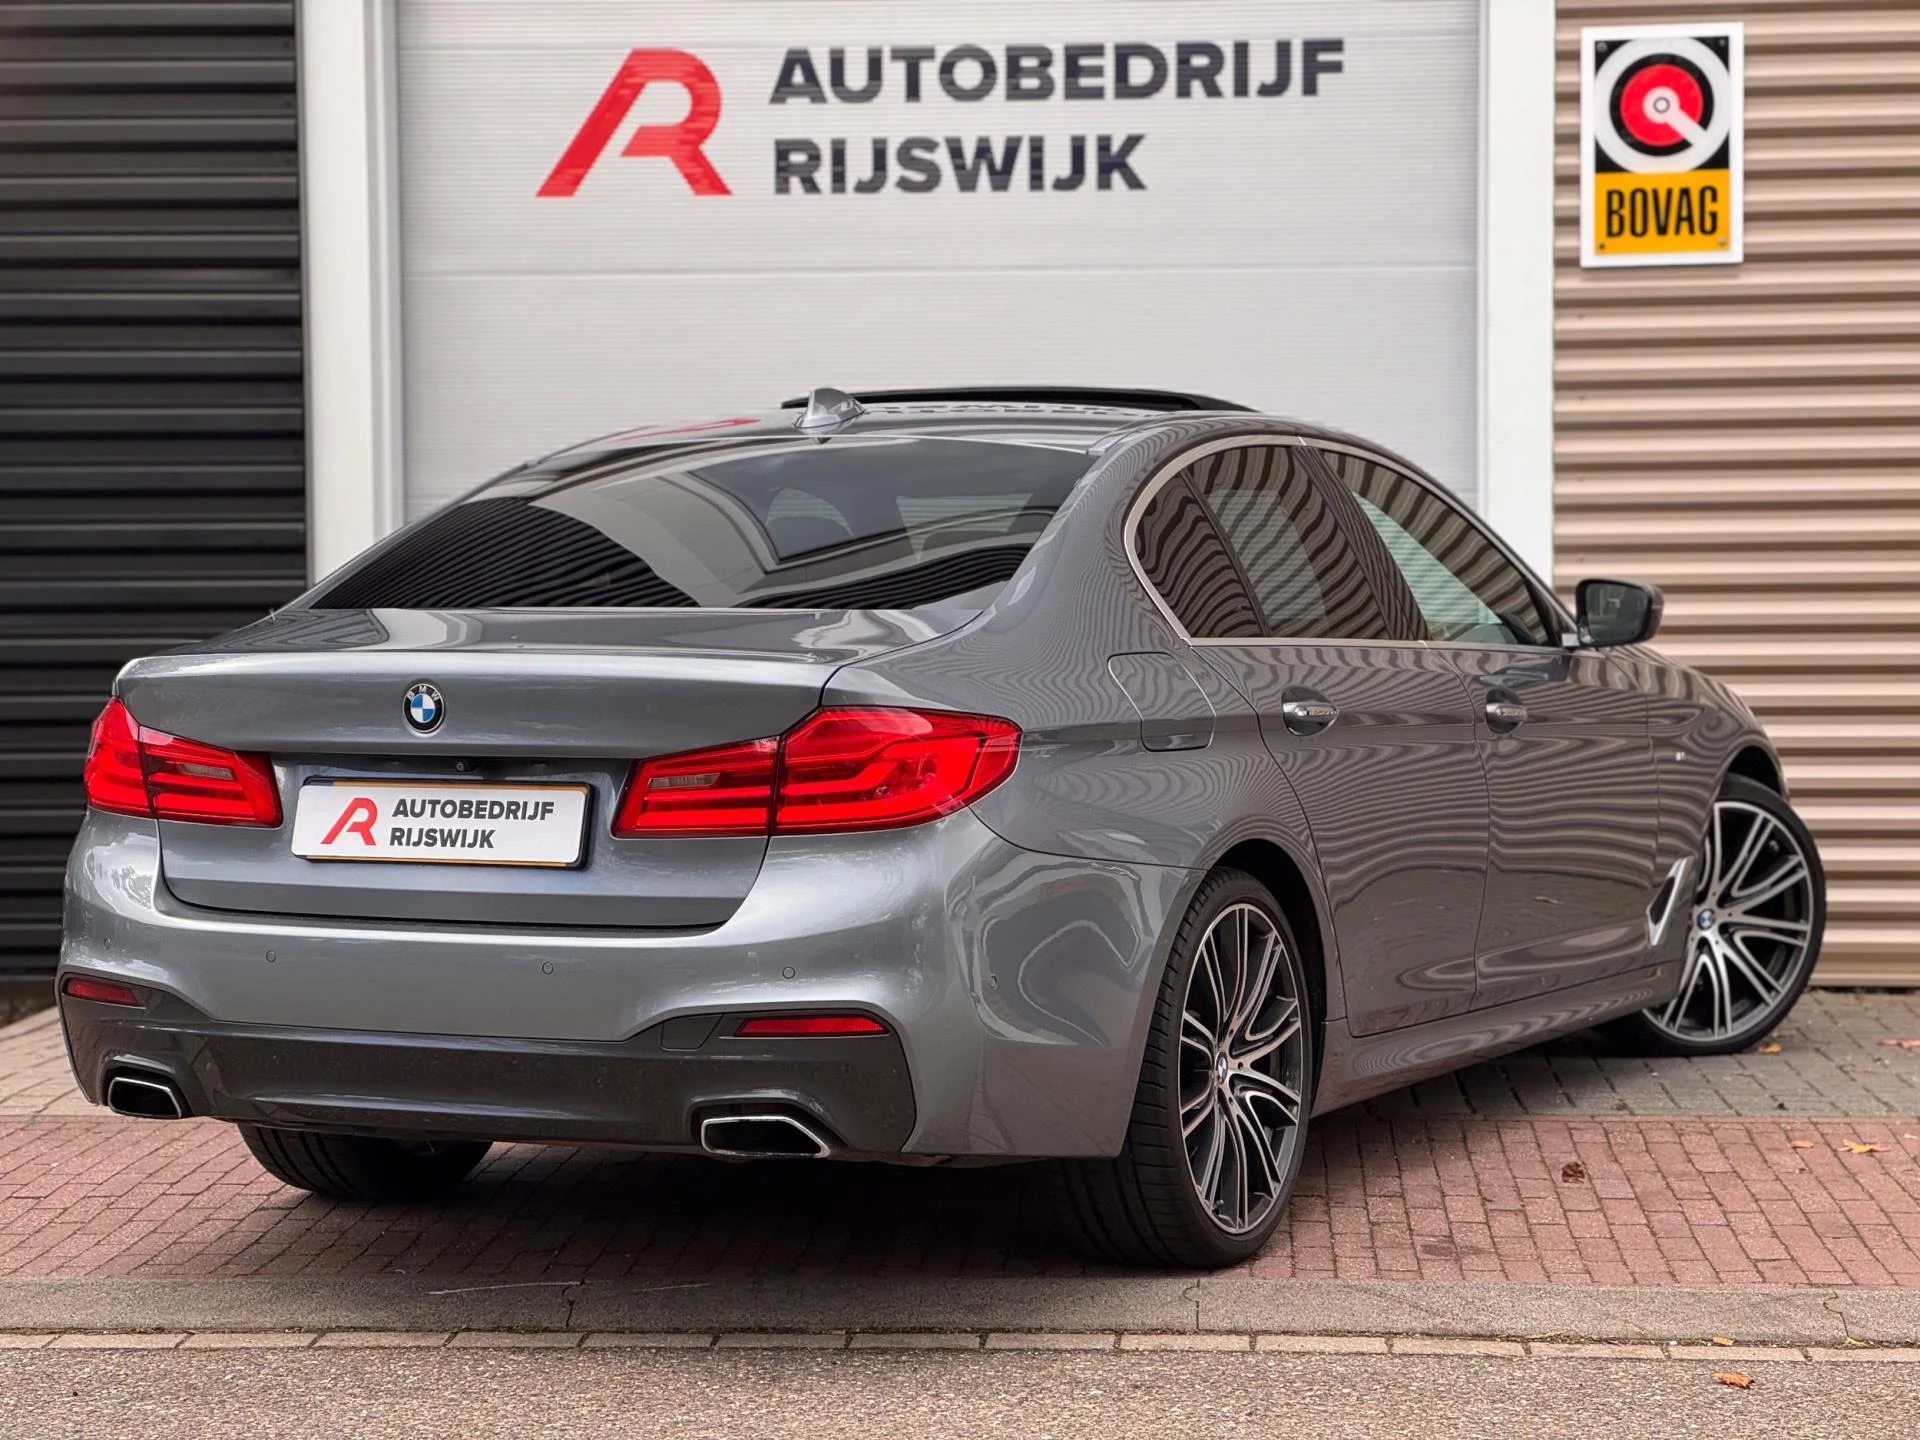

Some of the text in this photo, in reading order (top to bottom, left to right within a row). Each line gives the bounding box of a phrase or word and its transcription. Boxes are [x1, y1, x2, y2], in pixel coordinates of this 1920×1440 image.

[770, 38, 1345, 105] AUTOBEDRIJF
[773, 134, 1147, 195] RIJSWIJK
[1606, 185, 1719, 238] BOVAG
[406, 685, 441, 701] BMW
[392, 798, 555, 821] AUTOBEDRIJF
[389, 827, 496, 849] RIJSWIJK
